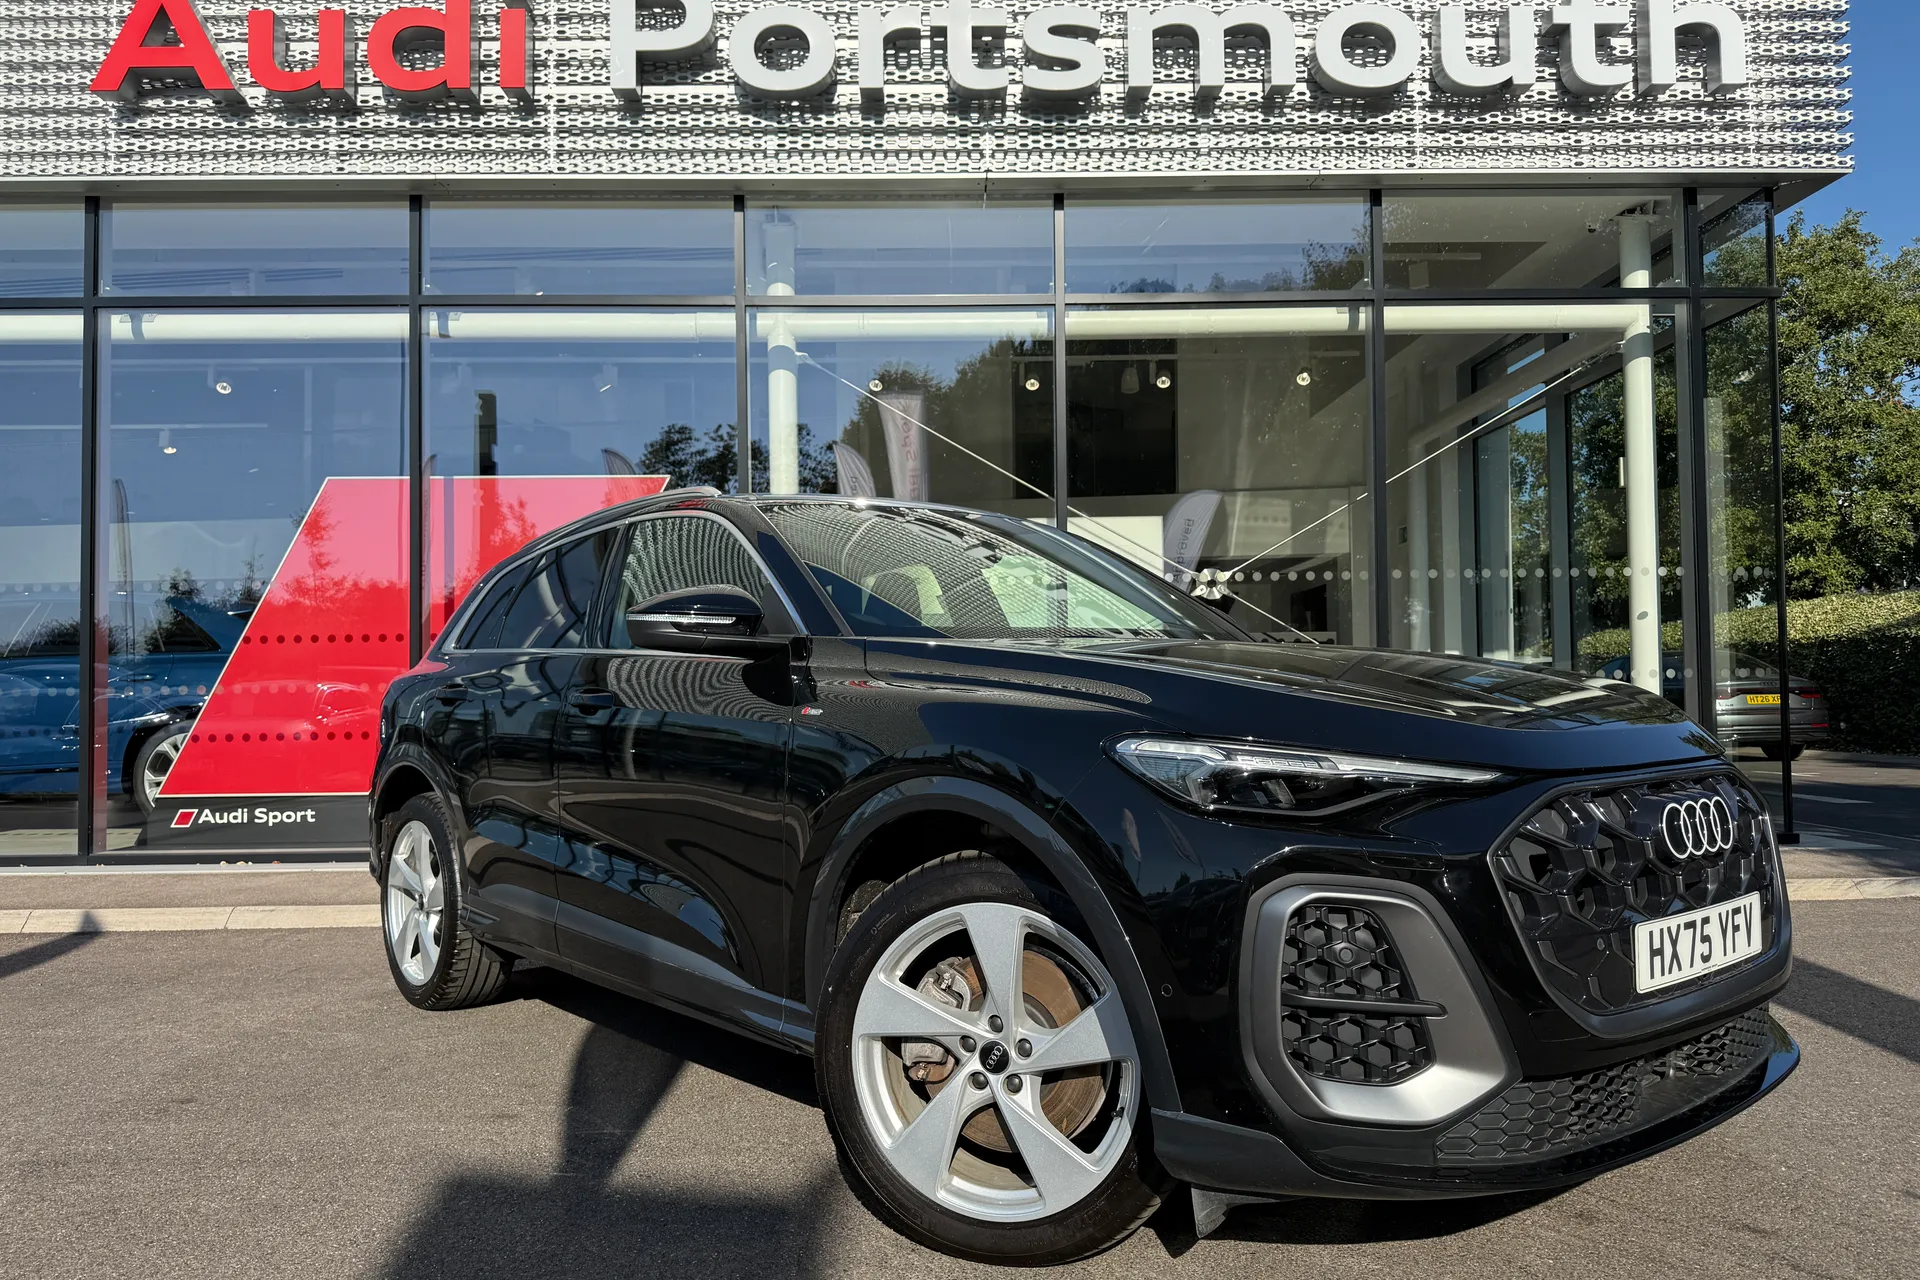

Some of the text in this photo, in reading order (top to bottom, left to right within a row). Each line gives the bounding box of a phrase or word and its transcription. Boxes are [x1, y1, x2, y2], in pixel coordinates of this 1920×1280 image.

[90, 0, 1748, 97] Audi Portsmouth
[198, 807, 316, 827] Audi Sport
[1648, 901, 1753, 981] HX75 YFV
